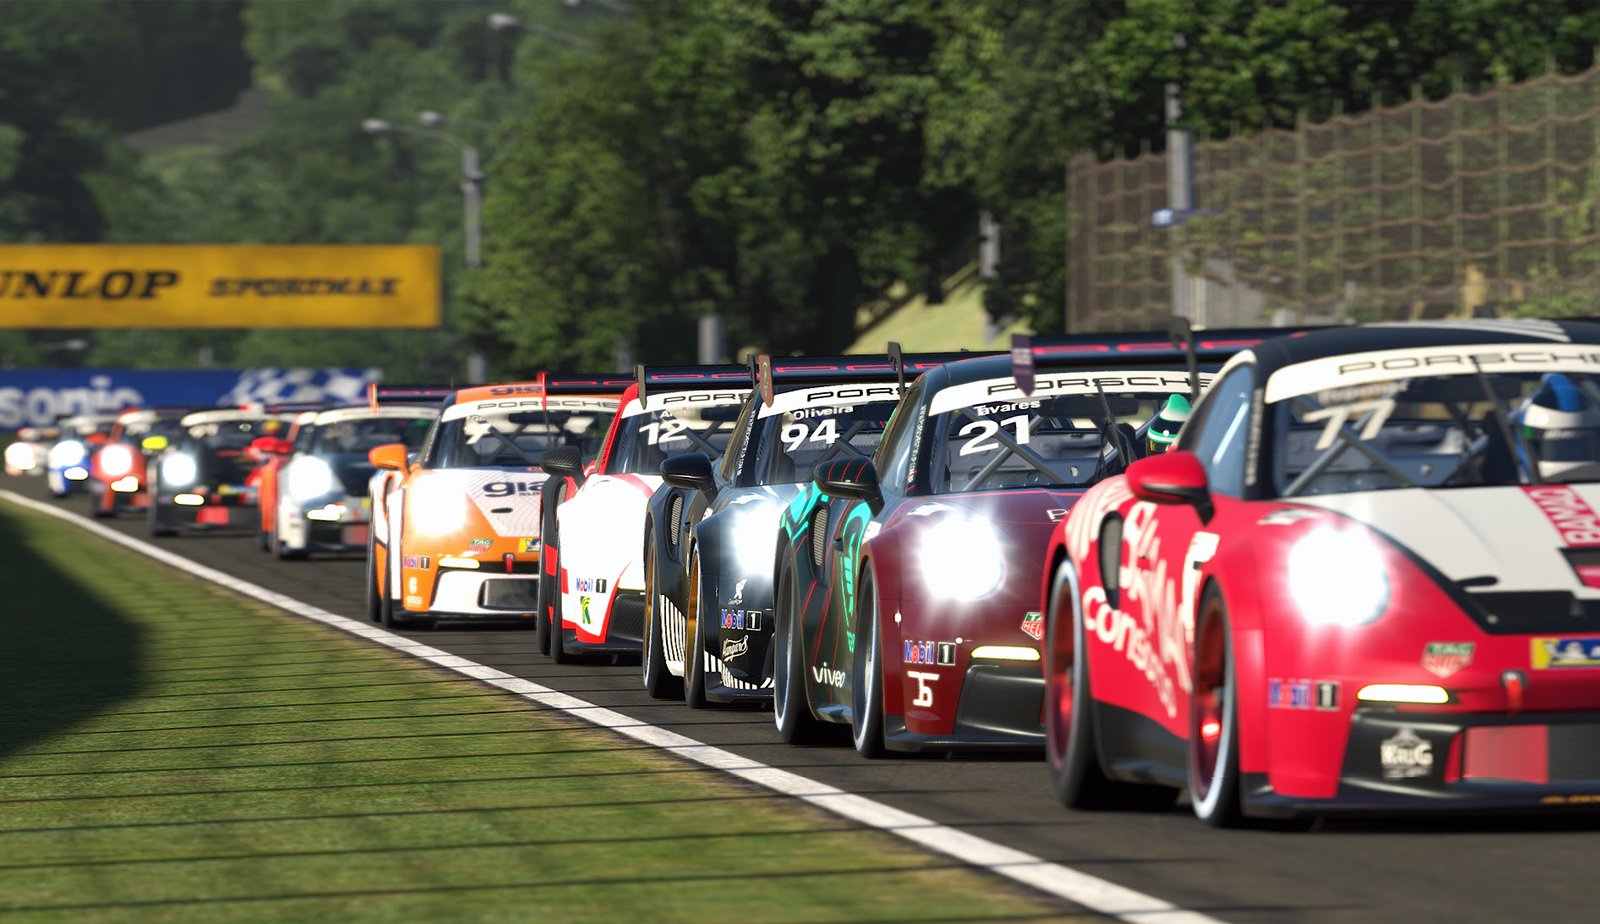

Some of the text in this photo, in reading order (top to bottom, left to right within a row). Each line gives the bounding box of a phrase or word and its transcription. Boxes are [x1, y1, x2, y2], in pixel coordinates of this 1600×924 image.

[1339, 352, 1600, 375] PORSCH
[794, 405, 854, 420] Oliveira
[973, 400, 1041, 417] Tavares
[639, 419, 687, 446] 12
[780, 418, 840, 452] 94
[959, 414, 1030, 456] 21
[1302, 399, 1396, 451] 77
[721, 609, 744, 630] Mobil
[904, 641, 935, 664] Mobil
[813, 662, 846, 688] viveo
